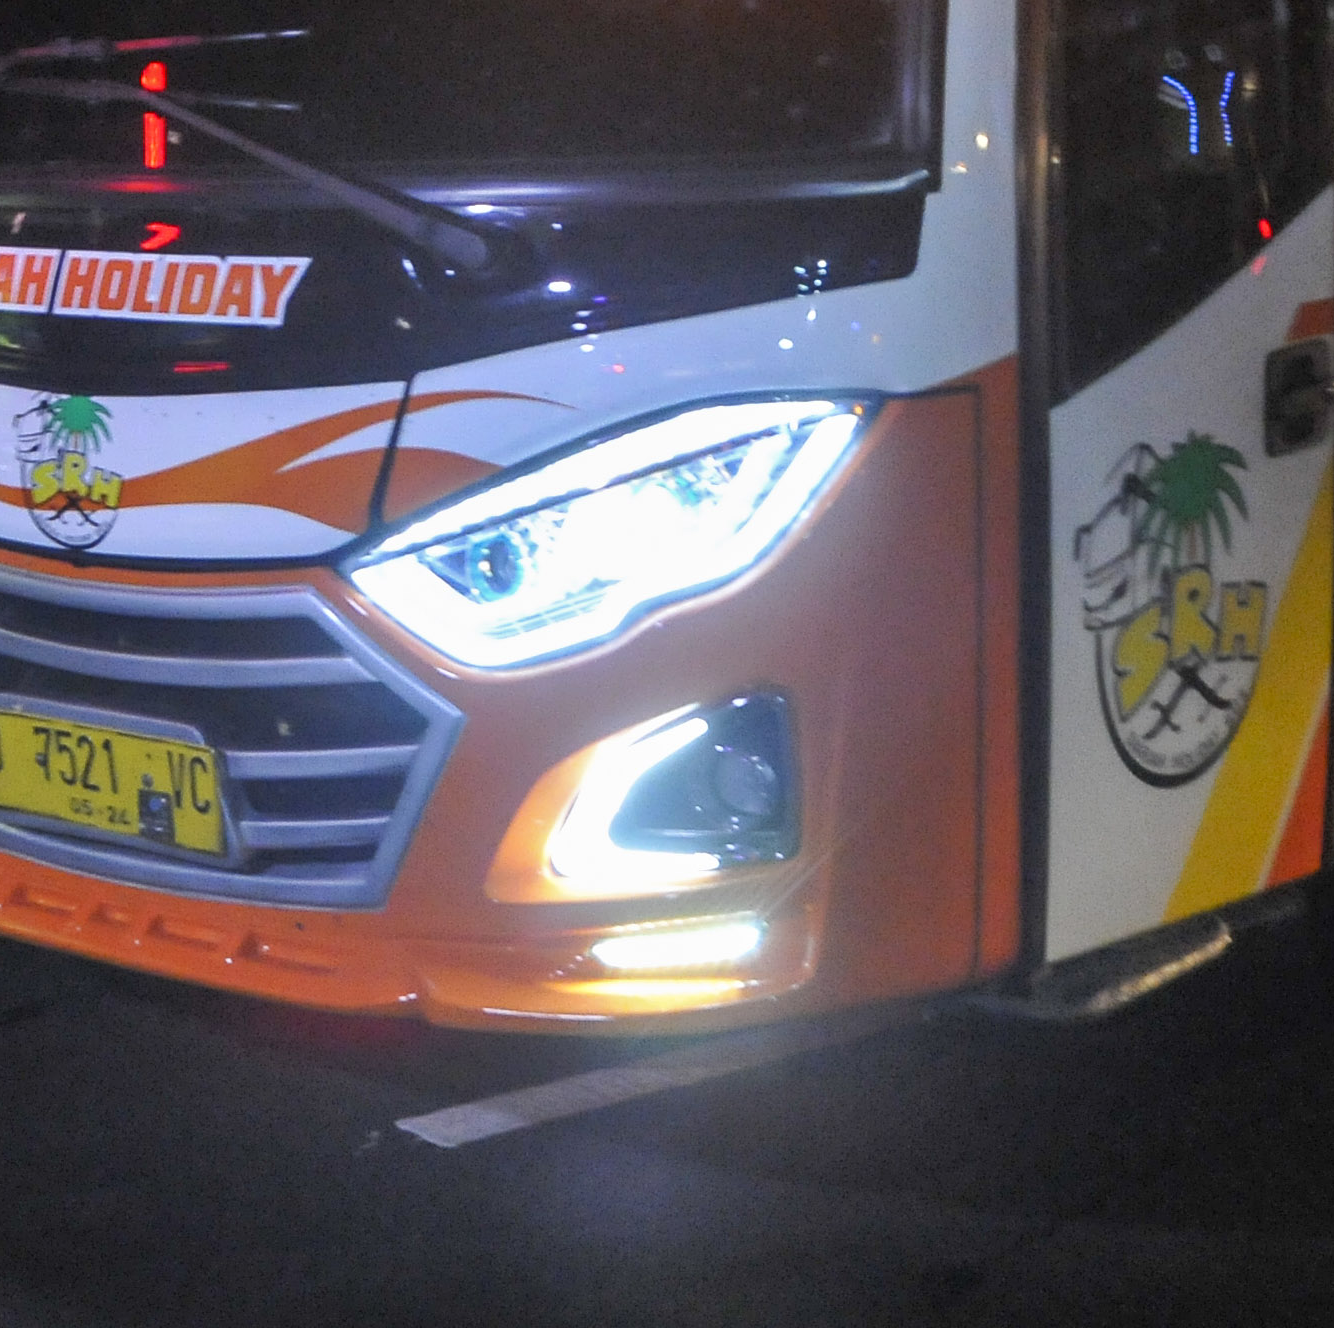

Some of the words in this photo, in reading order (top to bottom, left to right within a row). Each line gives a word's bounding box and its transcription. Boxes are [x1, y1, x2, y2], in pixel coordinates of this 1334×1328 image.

[54, 252, 304, 324] HOLIDAY
[29, 449, 123, 510] SRH
[1113, 564, 1268, 724] SRH
[33, 725, 119, 796] 7521
[167, 749, 212, 815] VC
